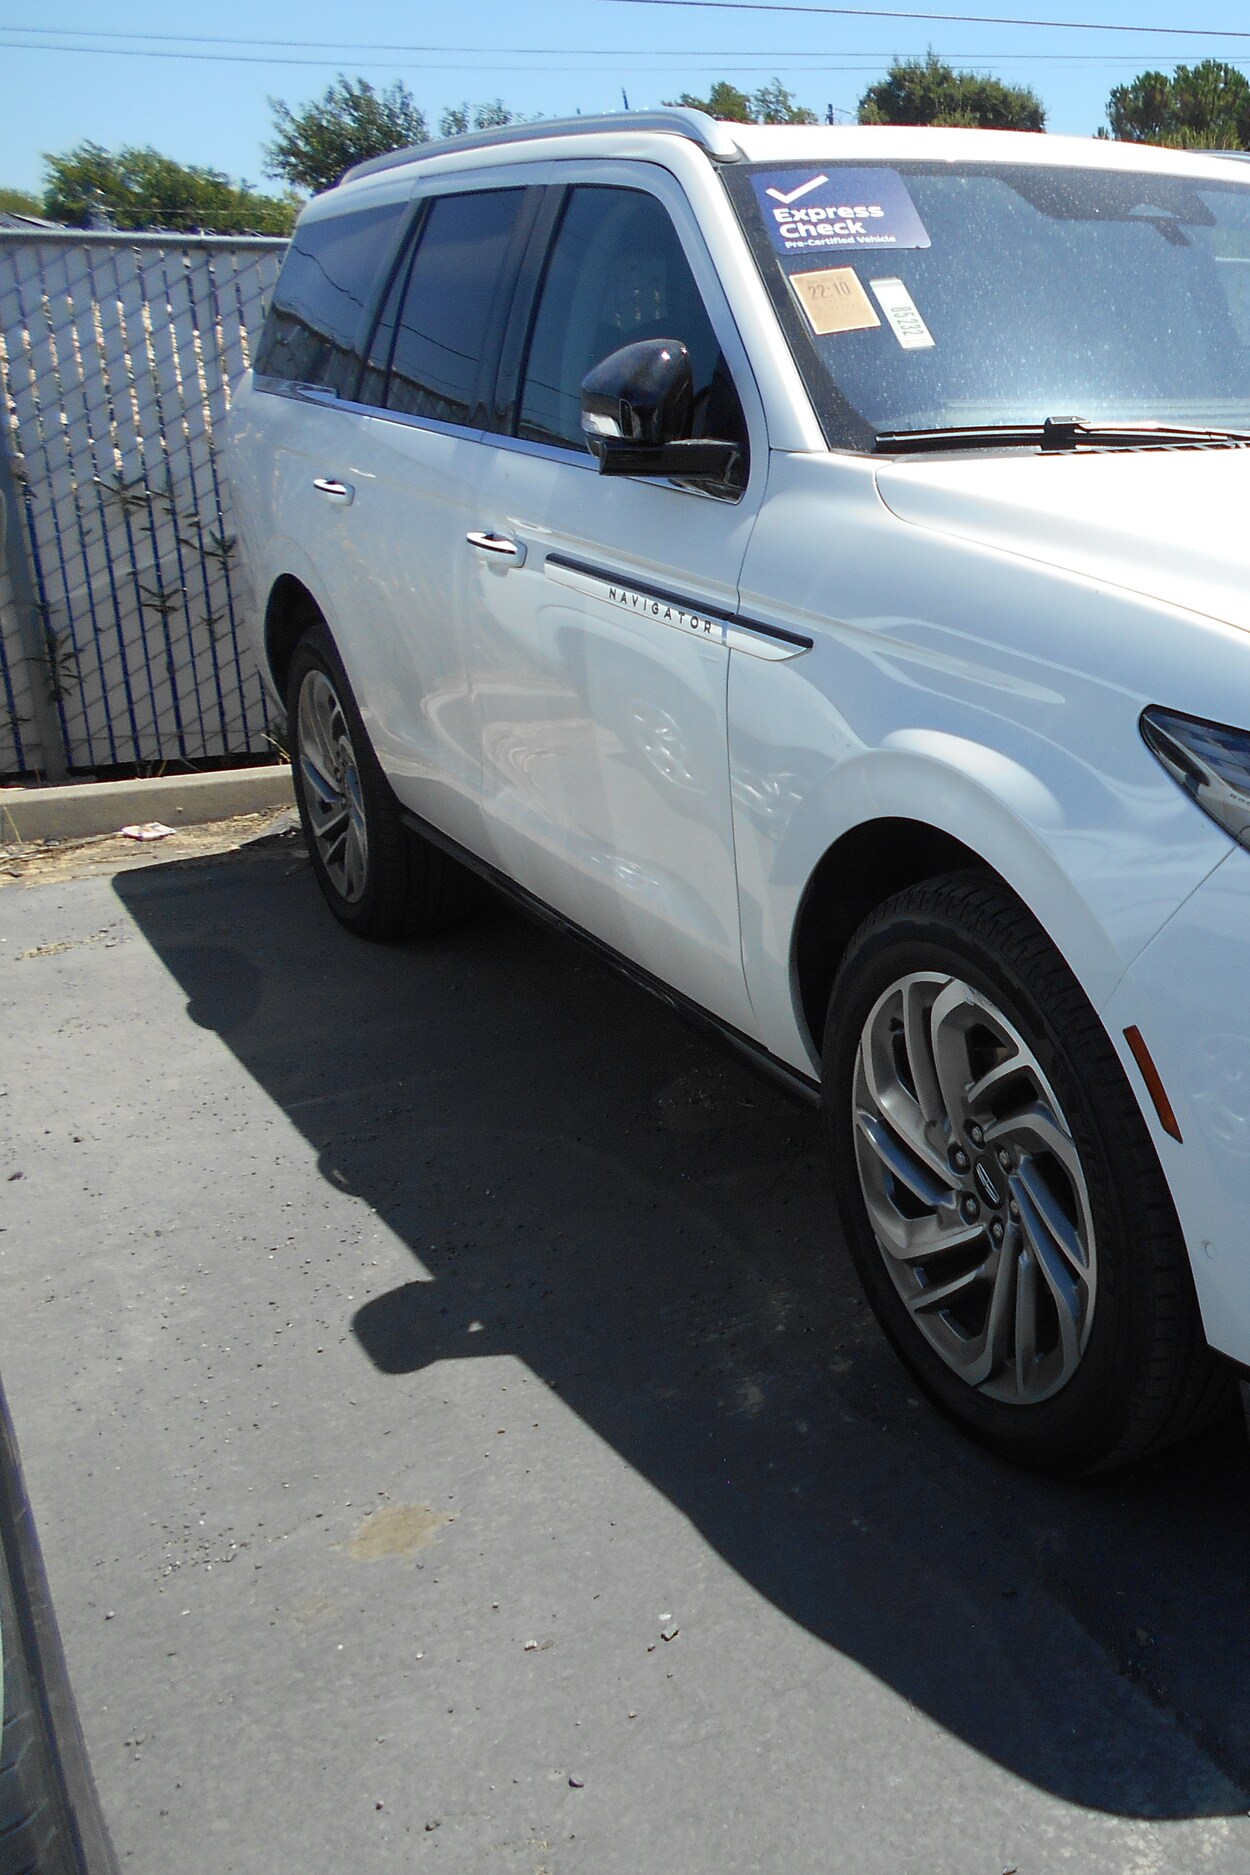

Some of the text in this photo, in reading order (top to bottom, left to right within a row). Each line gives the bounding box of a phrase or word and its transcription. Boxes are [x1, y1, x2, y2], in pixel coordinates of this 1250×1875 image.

[773, 206, 884, 223] Express
[779, 219, 867, 238] Check
[785, 235, 897, 248] Pre-Certified Vehicle
[609, 587, 711, 633] NAVIGATOR
